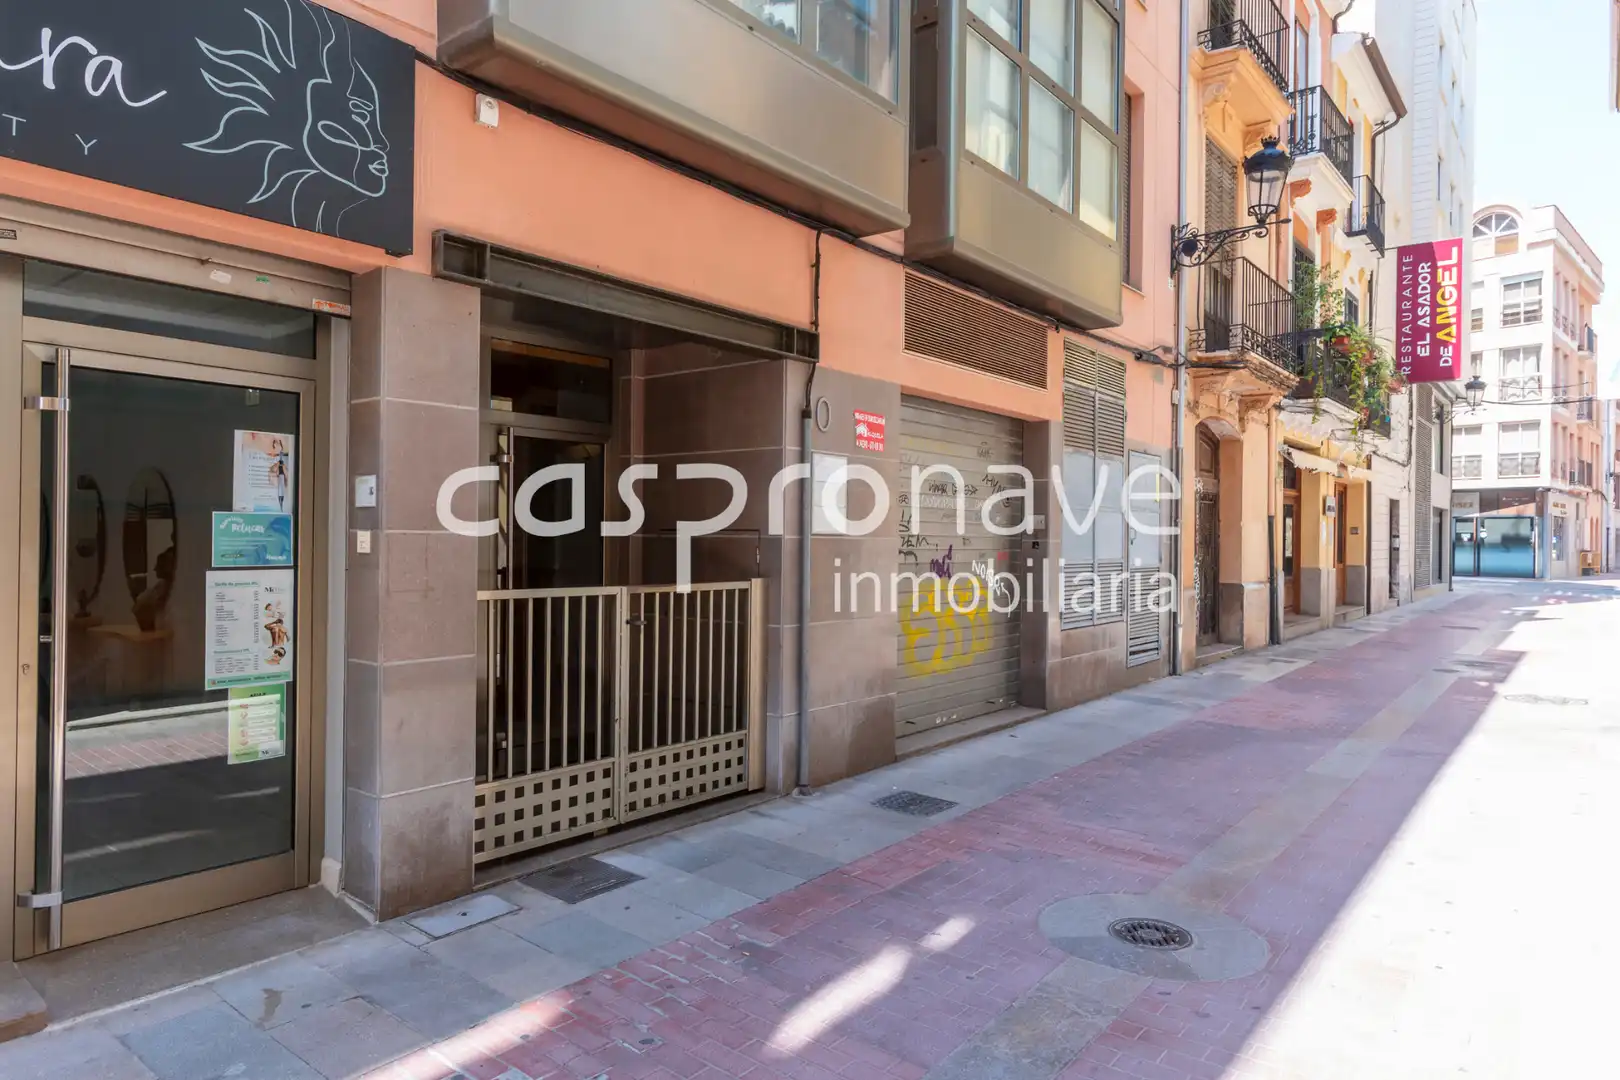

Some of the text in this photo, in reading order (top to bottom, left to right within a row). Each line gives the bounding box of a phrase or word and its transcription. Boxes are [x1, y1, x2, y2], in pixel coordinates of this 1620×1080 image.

[0, 27, 167, 107] ra
[1401, 254, 1413, 375] RESTAURANTE
[1417, 261, 1432, 357] EL ASADOR
[1436, 246, 1458, 367] DE ANGEL
